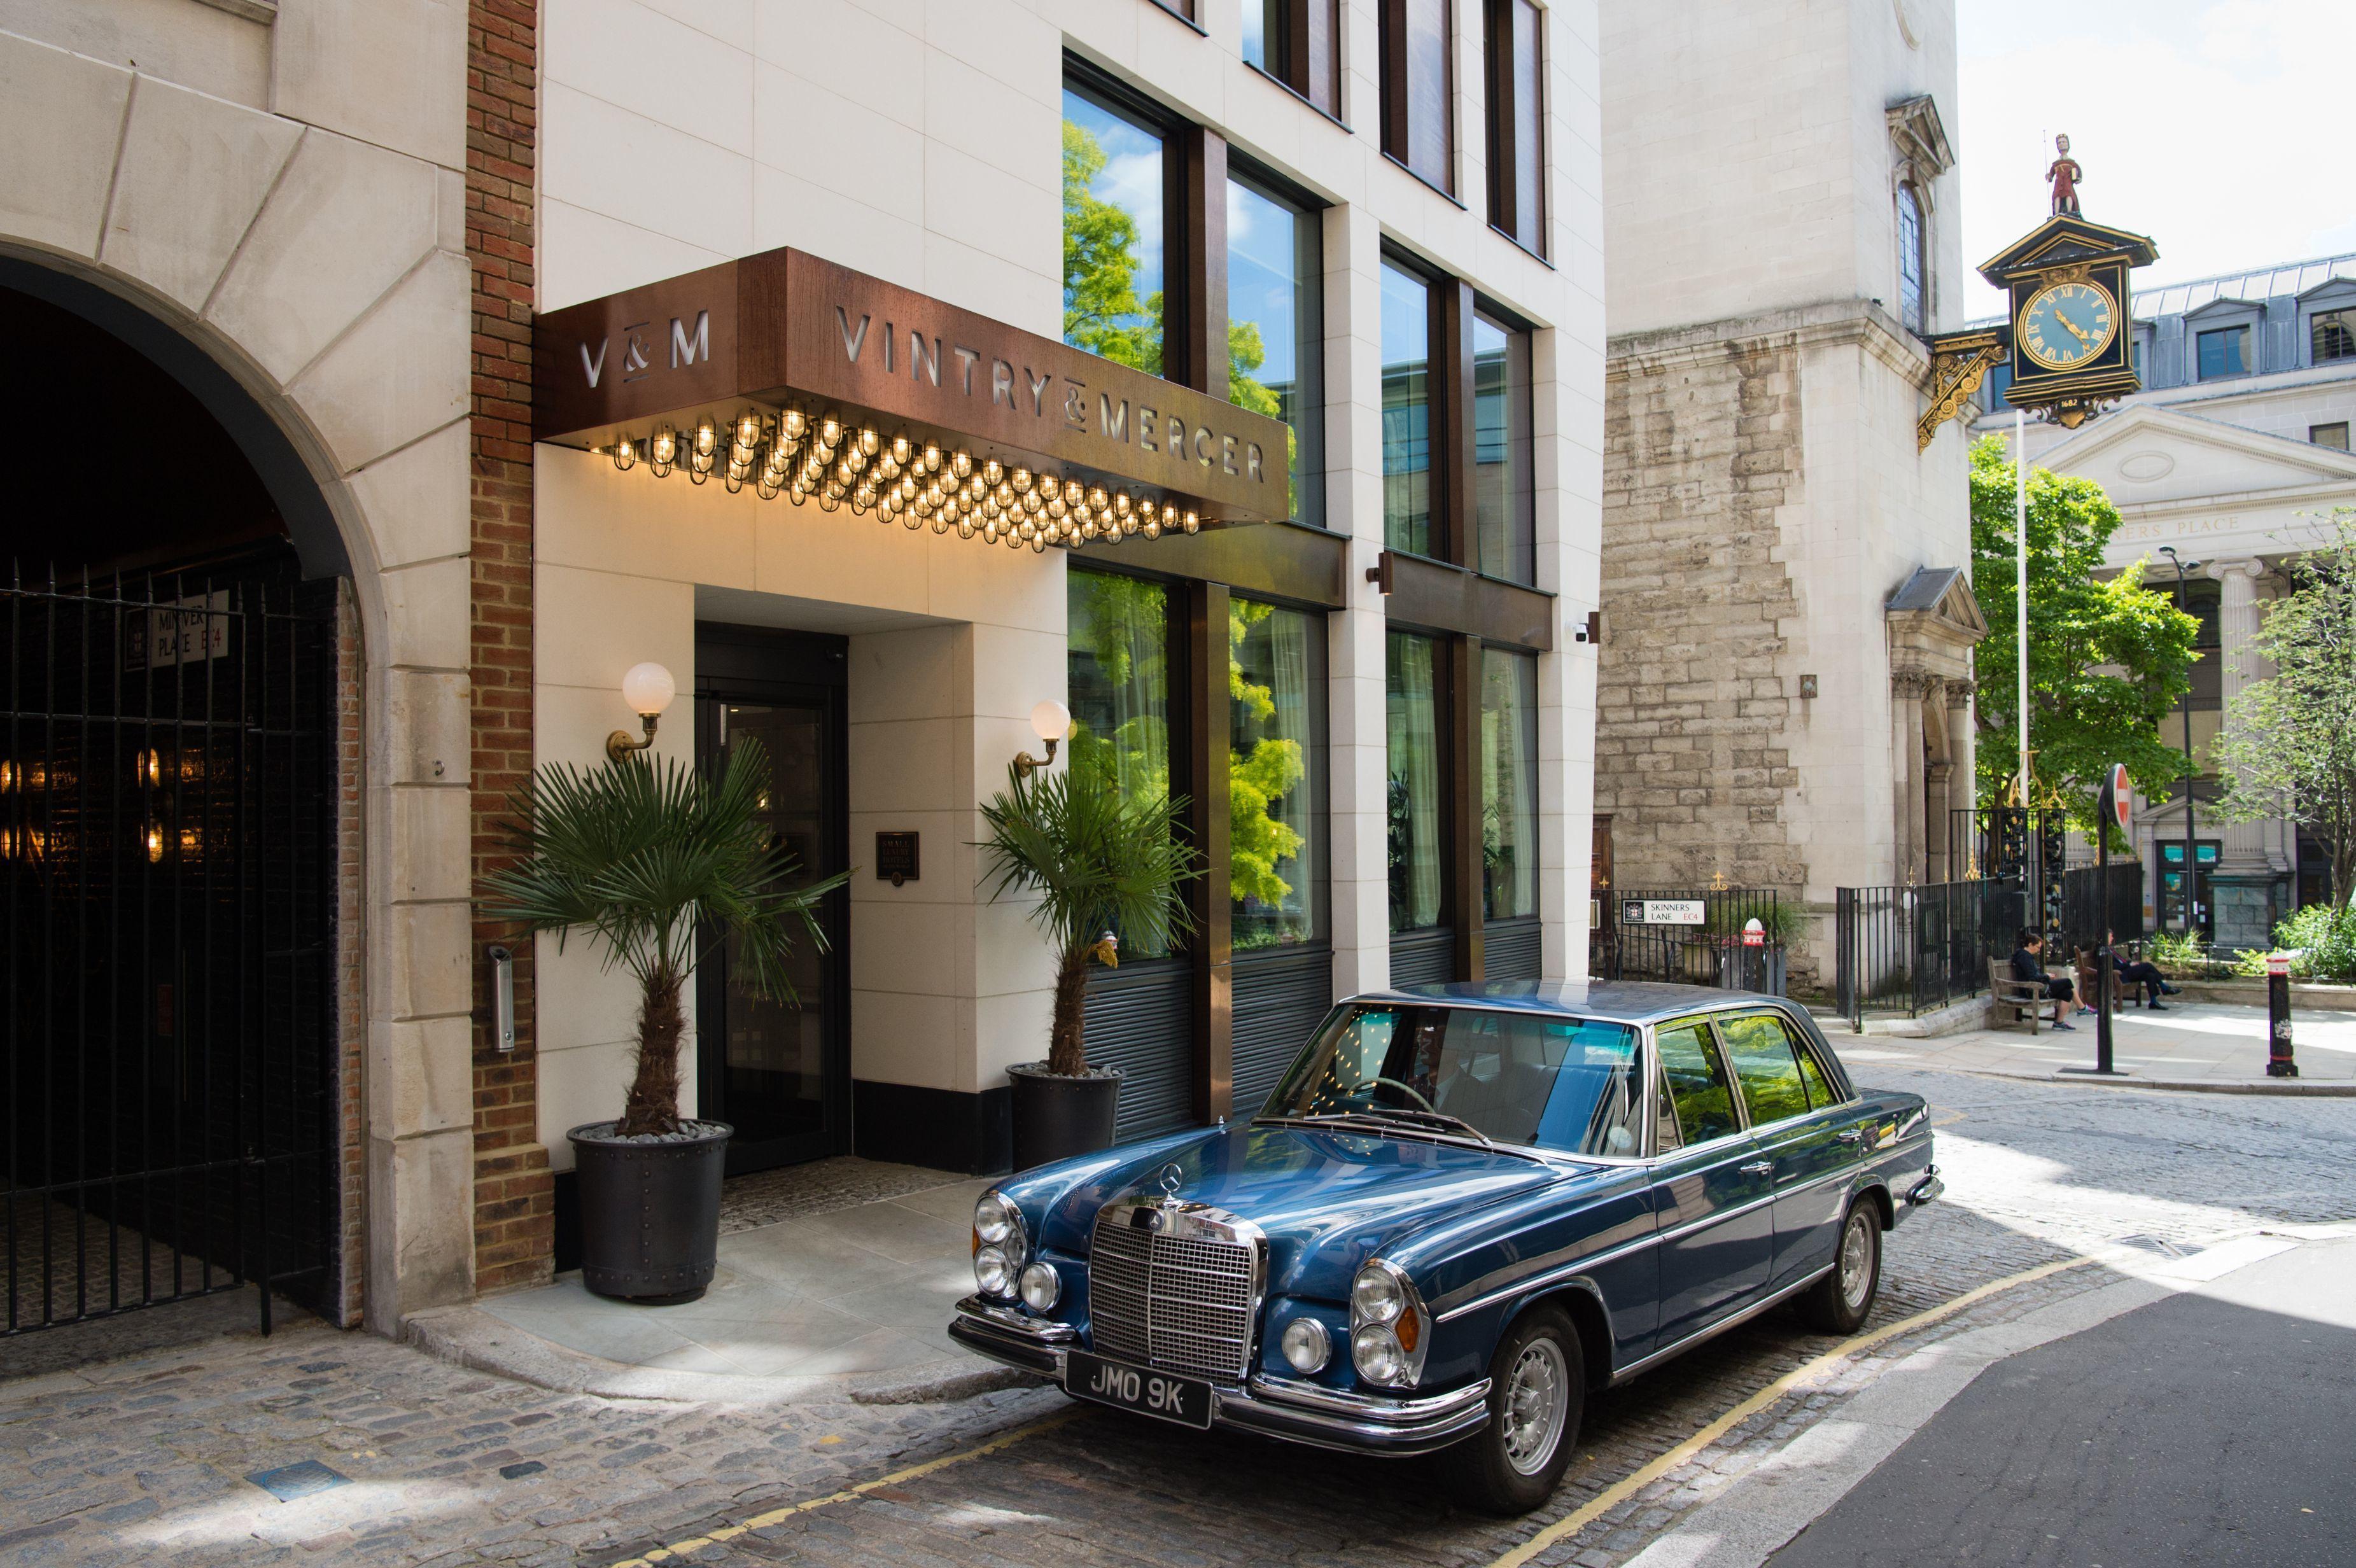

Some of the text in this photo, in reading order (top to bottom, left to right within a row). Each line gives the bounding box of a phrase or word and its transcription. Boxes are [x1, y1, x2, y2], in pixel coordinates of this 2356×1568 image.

[2061, 398, 2077, 407] 1682
[2178, 517, 2240, 535] PLACE
[159, 627, 221, 657] PLAE E4
[1090, 1365, 1184, 1414] JMO 9K
